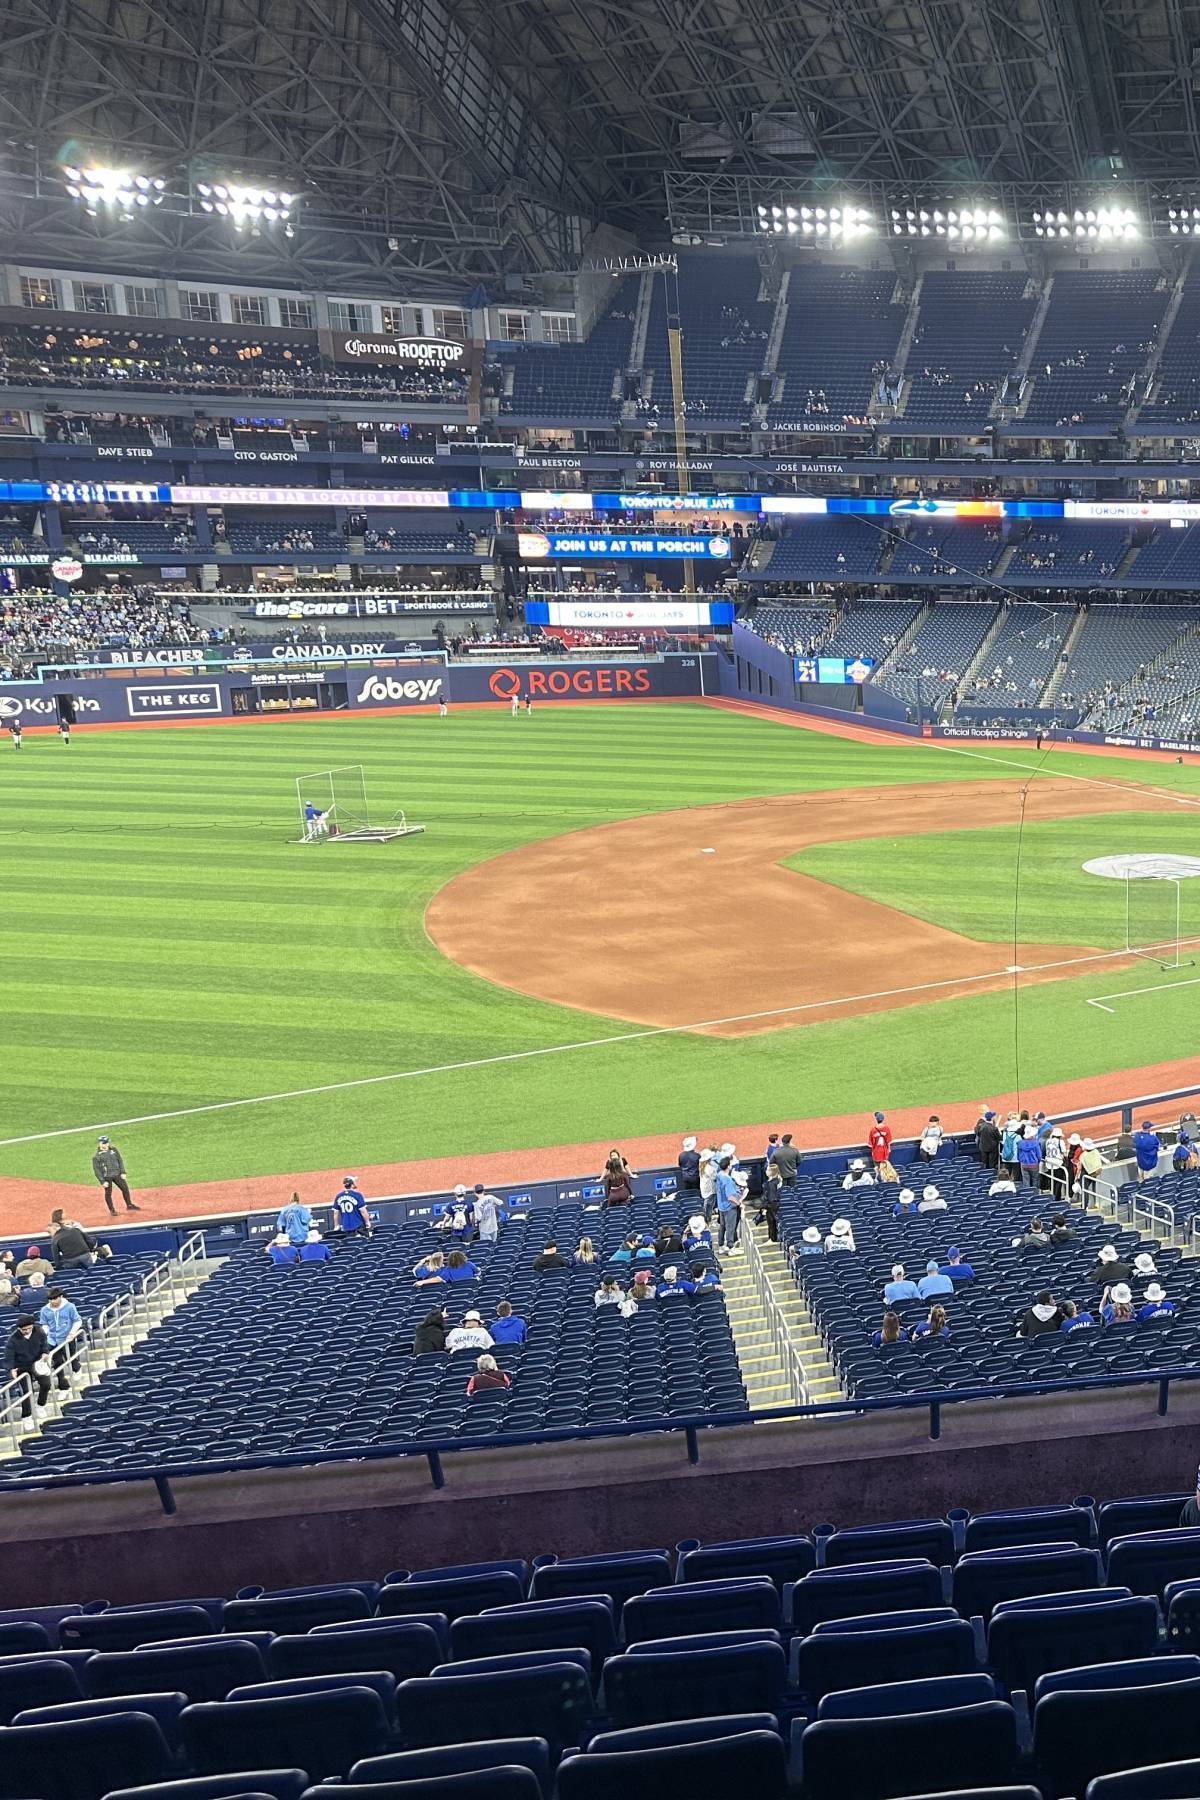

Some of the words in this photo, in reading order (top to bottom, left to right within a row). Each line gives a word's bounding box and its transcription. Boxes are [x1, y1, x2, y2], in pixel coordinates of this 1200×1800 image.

[345, 339, 397, 356] Corona
[399, 343, 463, 360] ROOFTOP
[419, 359, 446, 367] PATIO
[773, 423, 801, 431] JACKIE
[804, 423, 846, 431] ROBINSON
[98, 448, 123, 456] DAVE
[126, 449, 152, 457] STIEB
[234, 451, 256, 460] CITO
[260, 452, 297, 461] GASTON
[381, 456, 398, 464] PAT
[400, 456, 434, 465] GILLICK
[518, 459, 540, 467] PAUL
[542, 459, 581, 467] BEESTON
[650, 461, 667, 469] ROY
[669, 462, 713, 470] HALLADAY
[776, 463, 797, 471] JOSÉ
[802, 464, 843, 472] BAUTISTA
[619, 497, 672, 508] TORONTO
[684, 498, 708, 509] BLUE
[710, 498, 735, 509] JAYS
[555, 540, 585, 552] JOIN
[589, 540, 607, 552] US
[610, 540, 626, 552] AT
[630, 540, 653, 552] THE
[30, 555, 49, 563] DRY
[84, 554, 138, 563] BLEACHERS
[255, 601, 349, 616] theScore
[366, 600, 399, 613] BET
[404, 602, 451, 610] SPORTSBOOK
[573, 610, 624, 618] TORONTO
[272, 645, 346, 658] CANADA
[681, 659, 695, 667] 328
[799, 667, 817, 681] 21
[529, 669, 650, 694] ROGERS
[357, 676, 442, 702] Sobeys
[139, 695, 173, 706] THE
[178, 693, 210, 704] KEG
[944, 727, 969, 736] Official
[1001, 728, 1028, 738] Shingle
[1141, 739, 1153, 748] BET
[340, 1202, 354, 1213] 10
